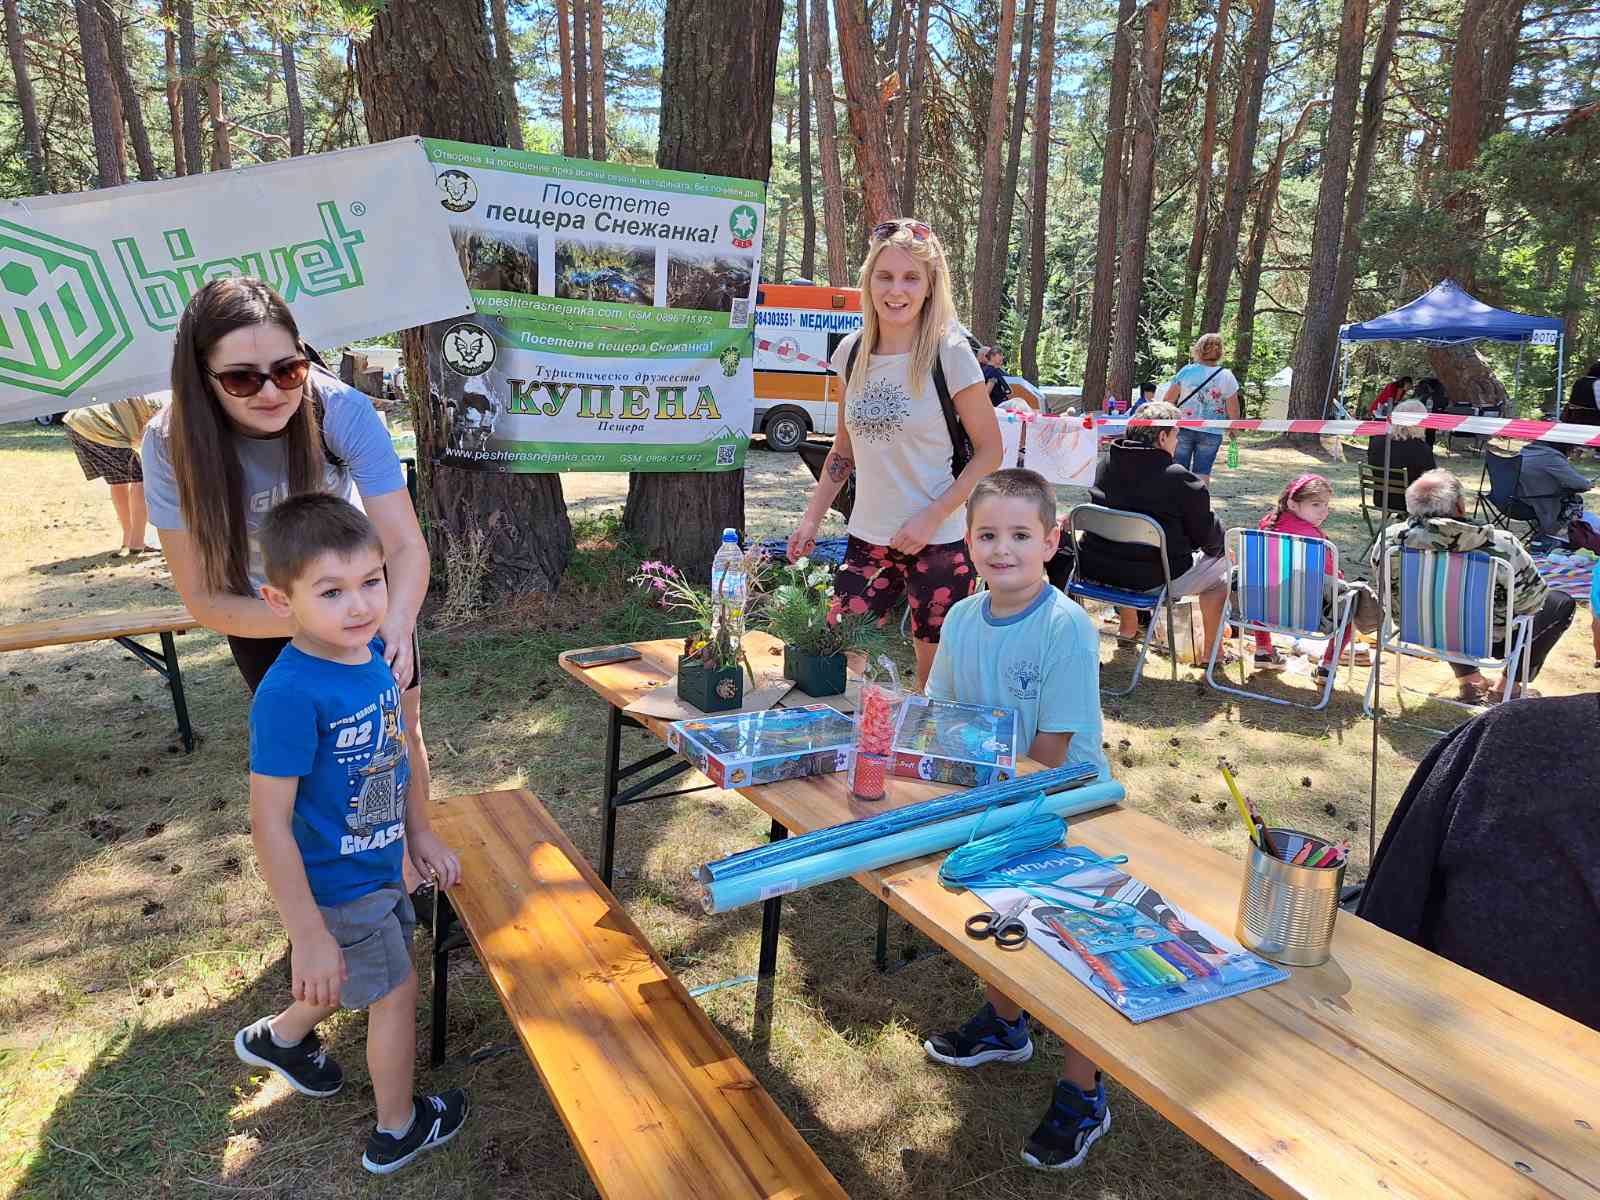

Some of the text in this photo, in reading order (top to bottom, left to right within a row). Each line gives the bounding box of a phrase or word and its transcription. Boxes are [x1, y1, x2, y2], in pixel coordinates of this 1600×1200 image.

[542, 183, 670, 216] Посетете
[486, 204, 719, 244] пещера Снежанка!
[520, 331, 713, 354] Посетете пещера Снежанка!
[535, 364, 701, 384] Туристическо дружество
[506, 378, 722, 420] КУПЕНА
[598, 421, 646, 433] Пещера
[335, 720, 373, 748] 02
